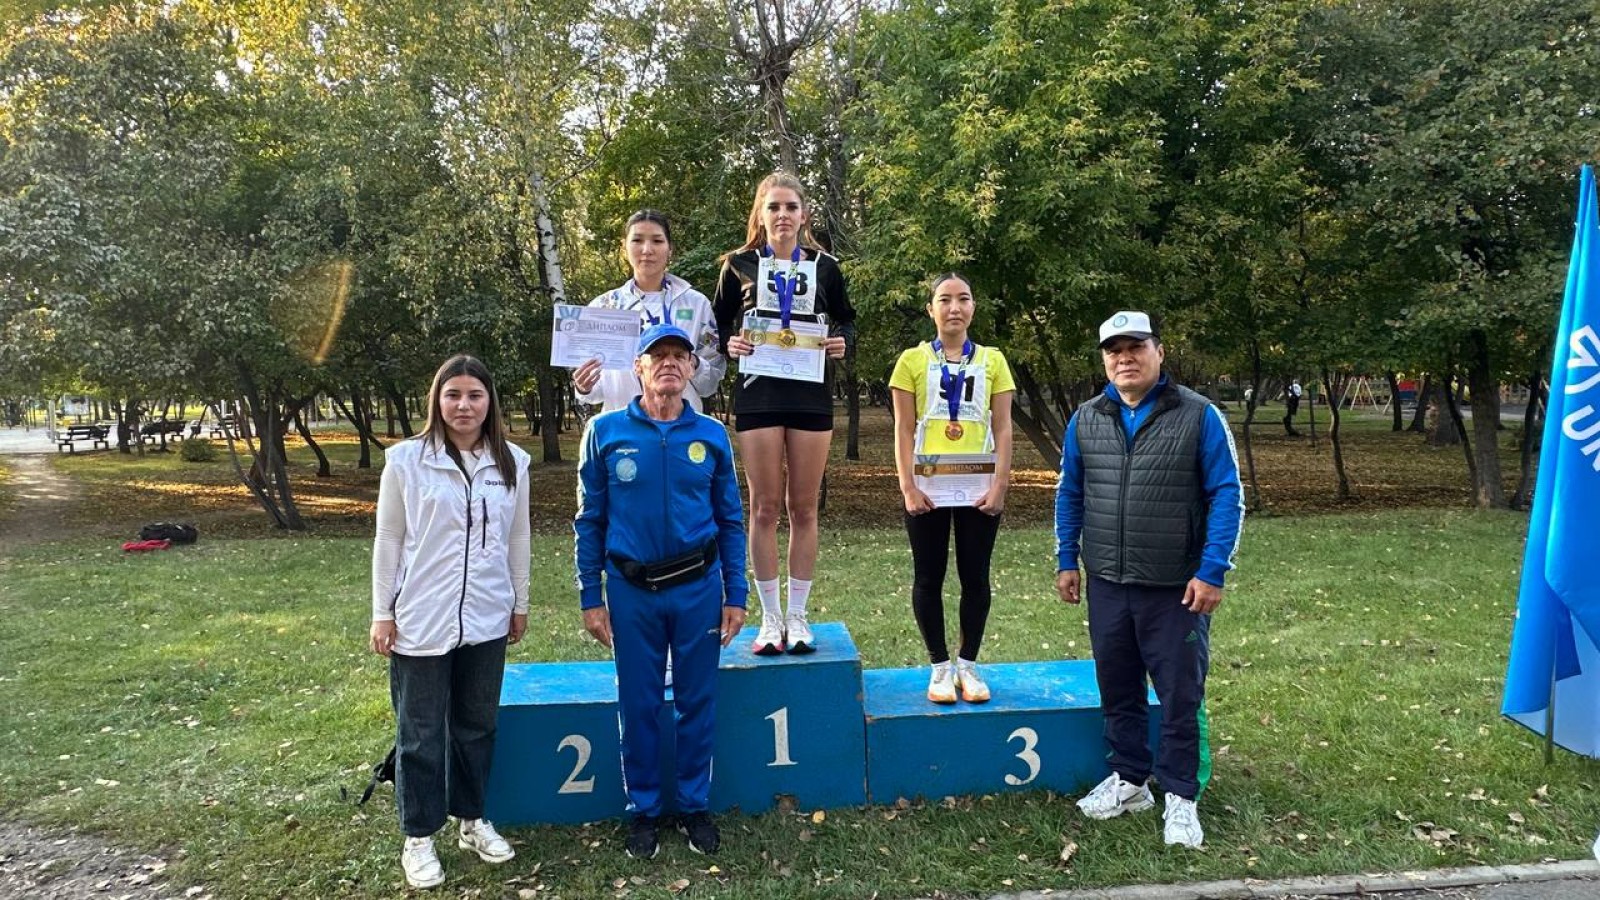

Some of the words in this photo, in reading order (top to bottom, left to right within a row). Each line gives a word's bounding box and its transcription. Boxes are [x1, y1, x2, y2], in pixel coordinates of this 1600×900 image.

[767, 270, 808, 296] 58
[586, 322, 627, 332] ДИПЛОМ
[557, 734, 596, 795] 2
[764, 706, 799, 767] 1
[1004, 726, 1041, 786] 3
